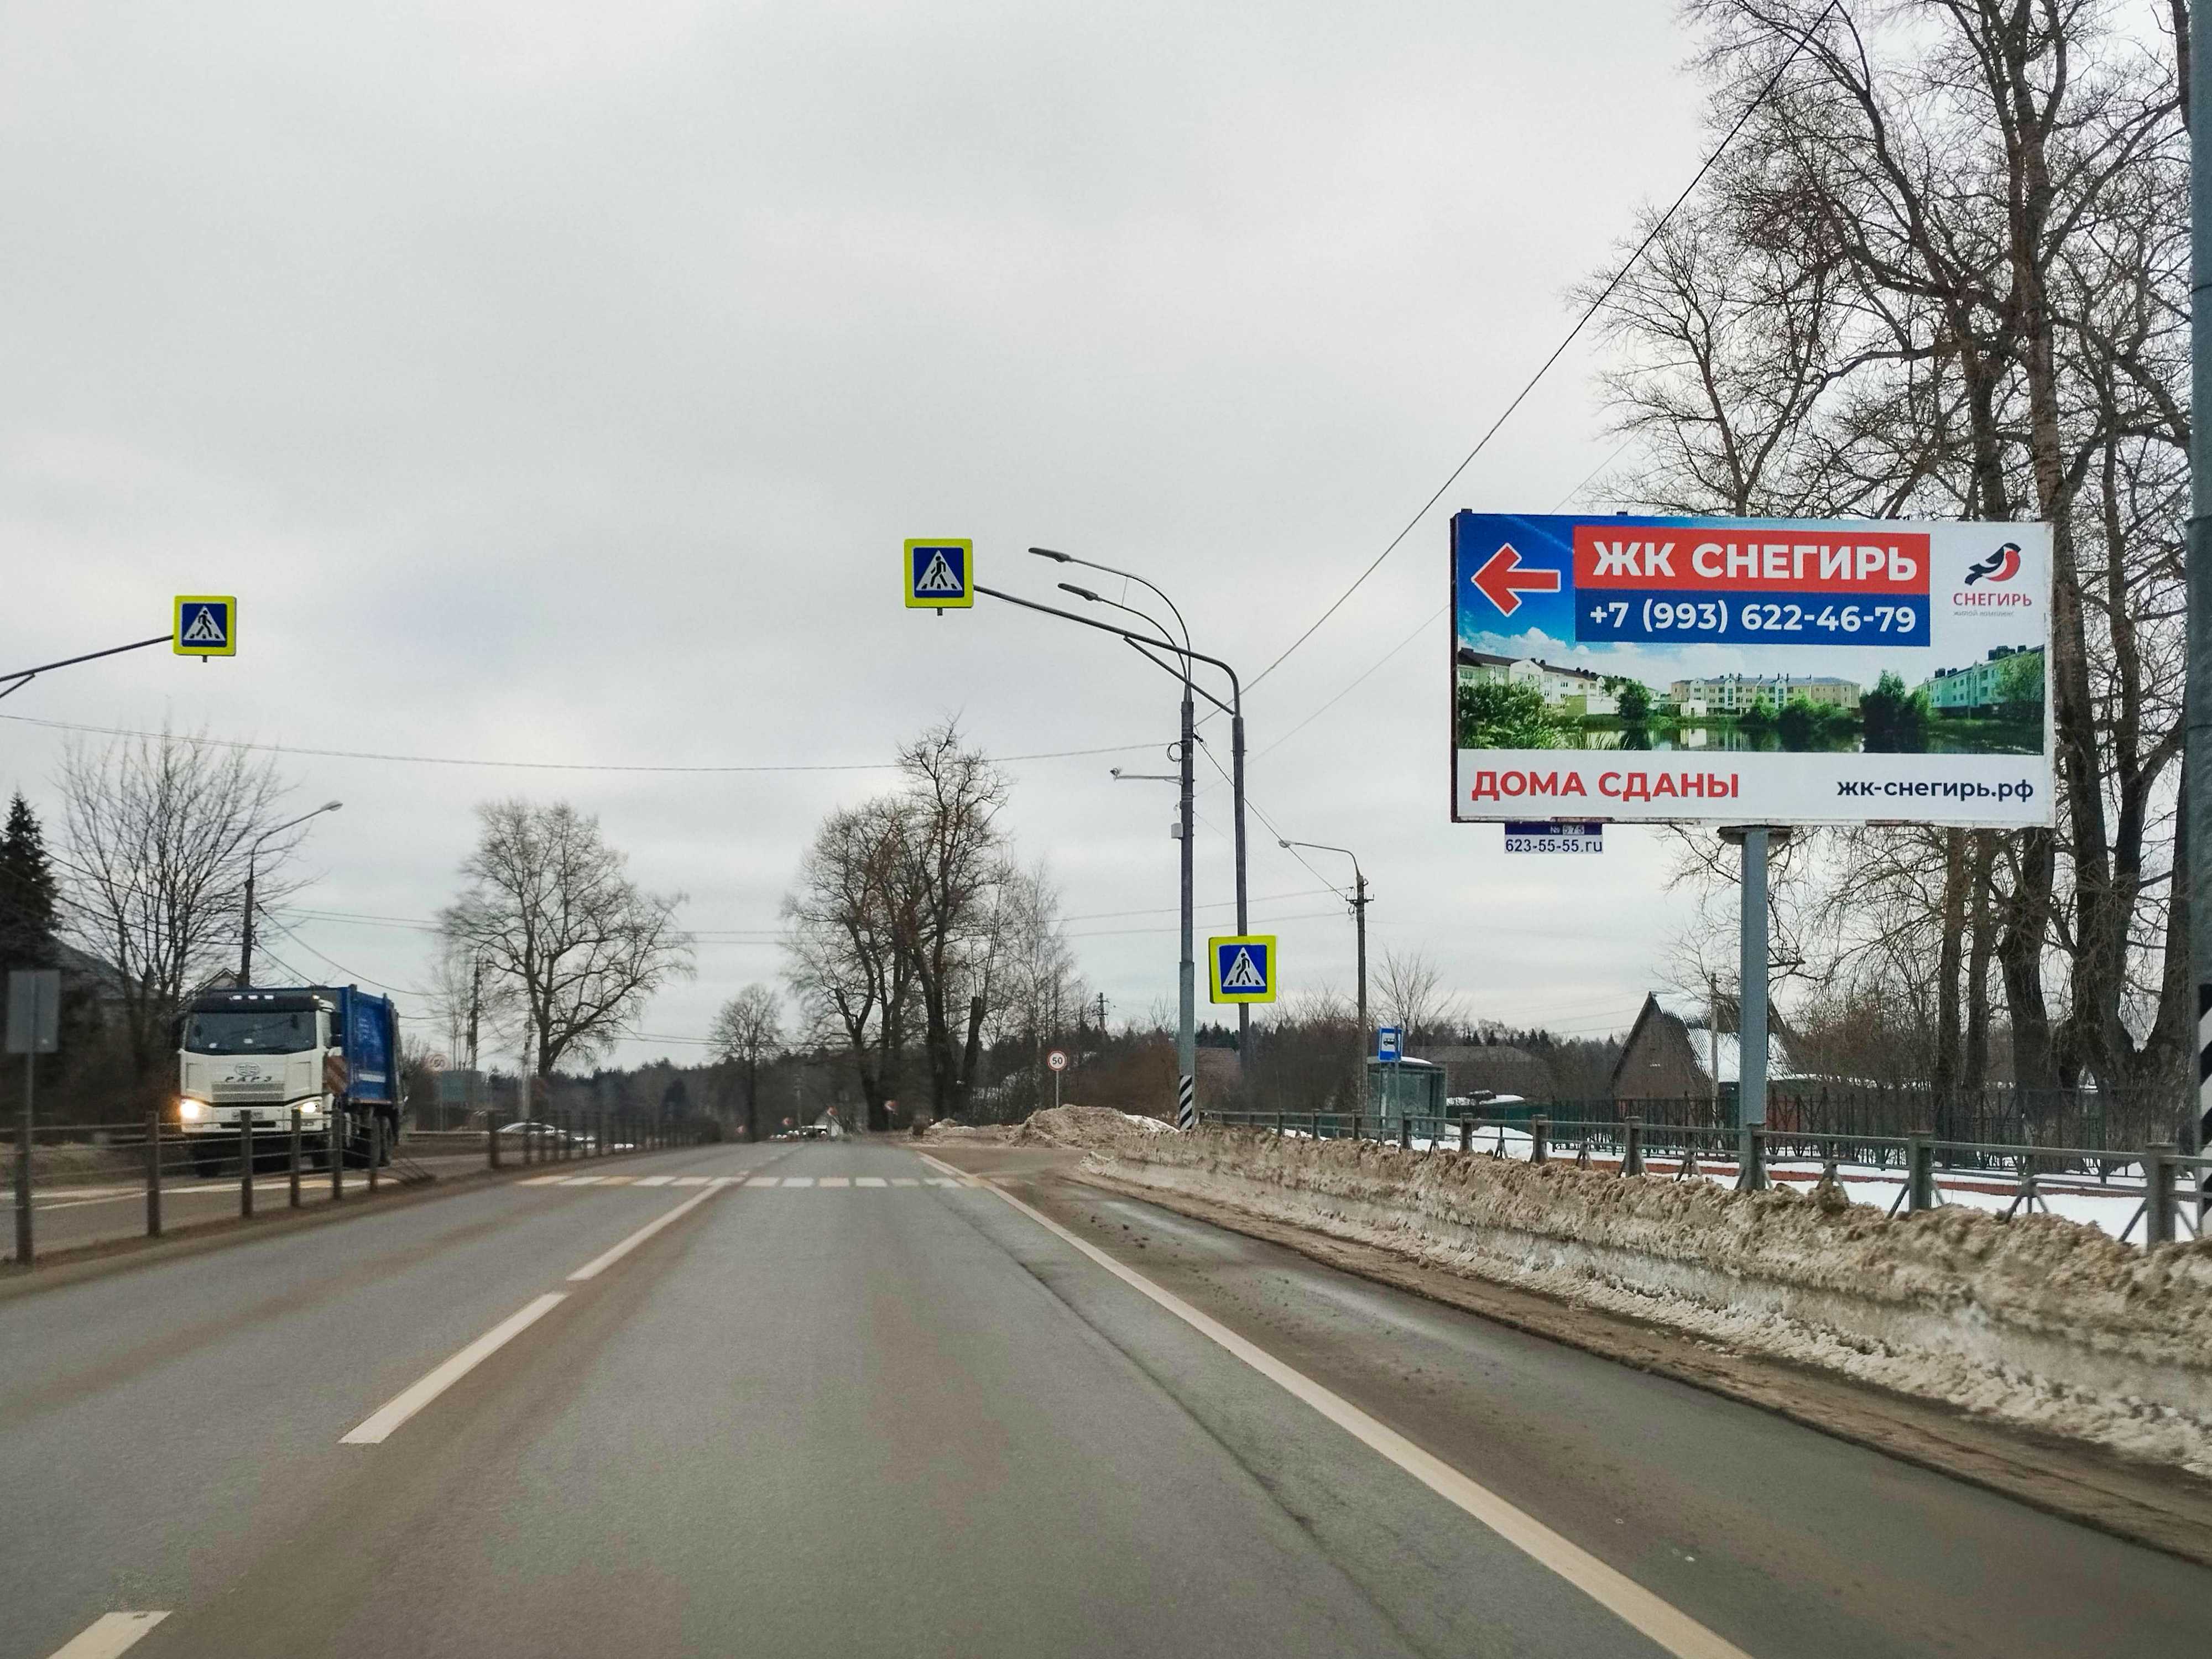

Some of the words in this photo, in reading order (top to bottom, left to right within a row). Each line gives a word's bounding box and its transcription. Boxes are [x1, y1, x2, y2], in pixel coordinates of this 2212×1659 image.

[1593, 541, 1676, 577] ЖК
[1692, 543, 1917, 581] СНЕГИРЬ
[1953, 592, 2032, 607] СНЕГИРЬ
[1590, 602, 1629, 628] +7
[1643, 599, 1728, 633] (993)
[1741, 604, 1916, 633] 622-46-79
[1472, 771, 1587, 801] ДОМА
[1598, 772, 1739, 801] СДАНЫ
[1837, 779, 2033, 802] жк-снегирь.рф
[1505, 838, 1602, 852] 623-55-55.ru
